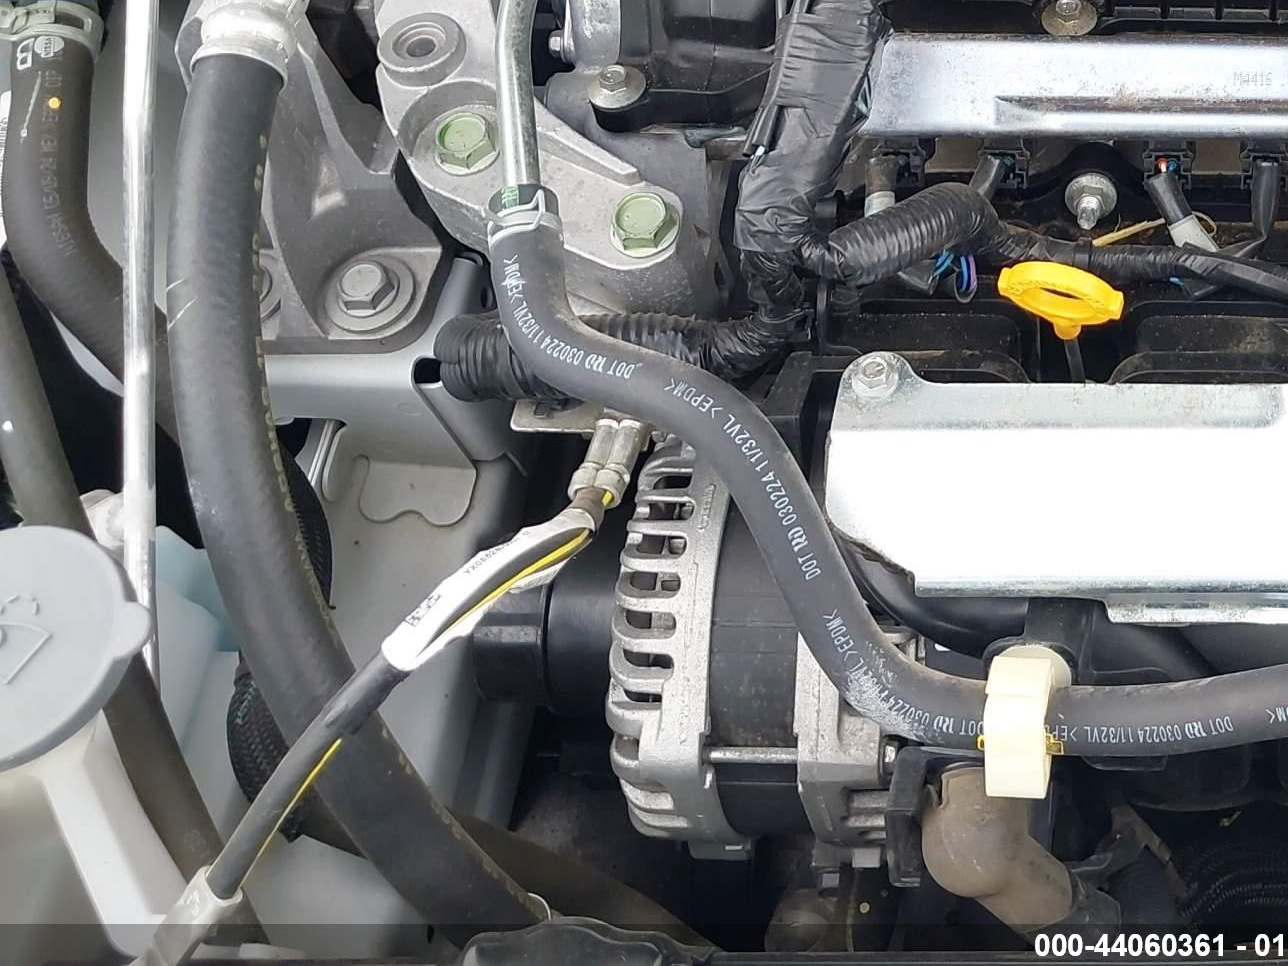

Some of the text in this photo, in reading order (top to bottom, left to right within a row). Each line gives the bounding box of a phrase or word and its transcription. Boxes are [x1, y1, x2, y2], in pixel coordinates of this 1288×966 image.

[540, 335, 584, 366] 030224
[607, 359, 635, 379] DOT
[760, 467, 797, 526] 030224
[795, 554, 820, 581] DOT
[1137, 724, 1182, 741] 030224
[1207, 715, 1234, 735] DOT
